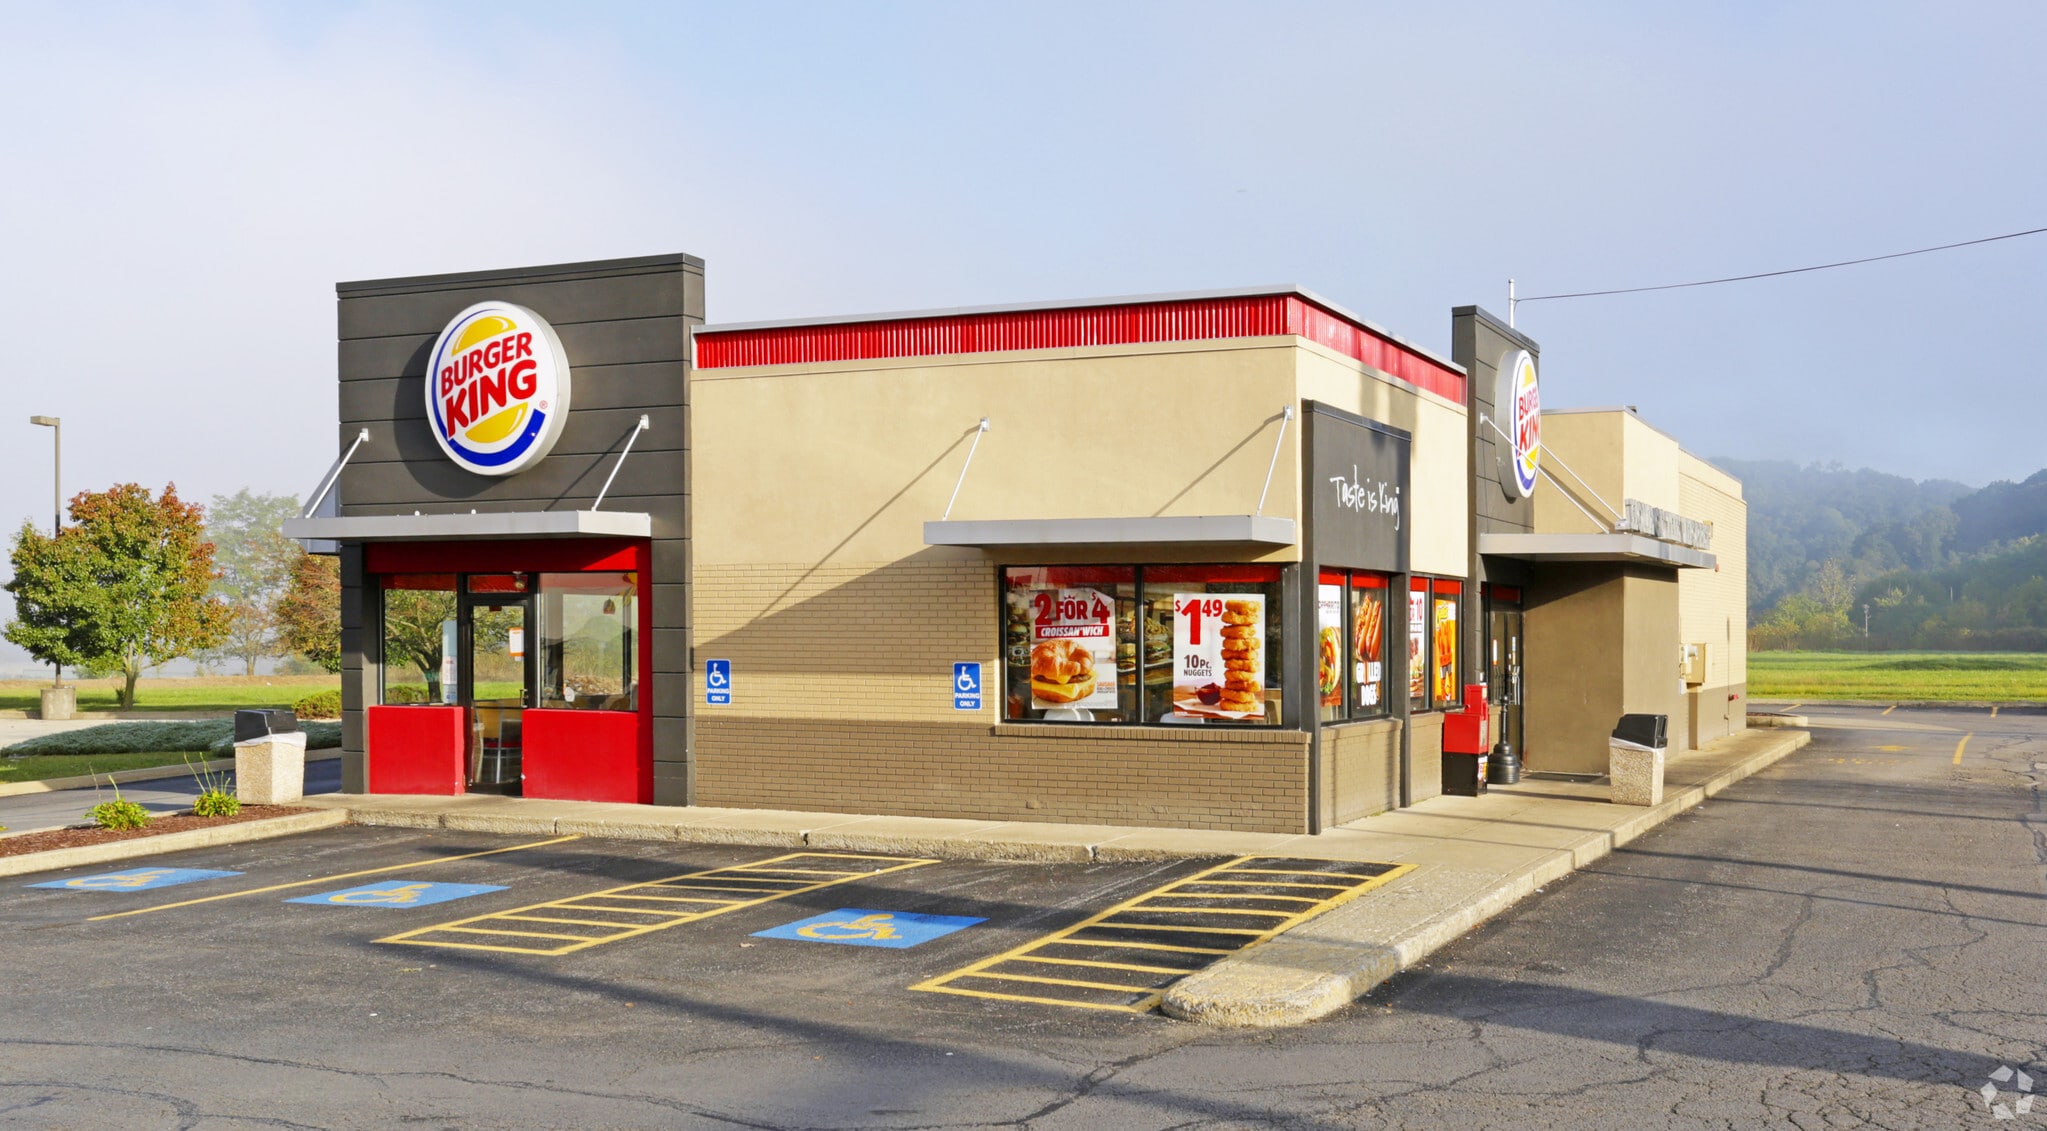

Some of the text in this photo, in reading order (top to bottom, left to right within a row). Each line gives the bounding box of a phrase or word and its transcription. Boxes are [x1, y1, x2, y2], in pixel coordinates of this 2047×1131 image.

[441, 332, 533, 399] BURGER
[446, 359, 537, 438] KING
[1518, 386, 1539, 422] BURGE
[1517, 414, 1540, 457] KIN
[1329, 464, 1365, 512] Taste
[1366, 477, 1378, 513] is
[1034, 593, 1052, 625] 2
[1055, 599, 1088, 621] FOR
[1040, 626, 1104, 637] CROISSAN'WICH
[1183, 669, 1212, 677] NUGGETS
